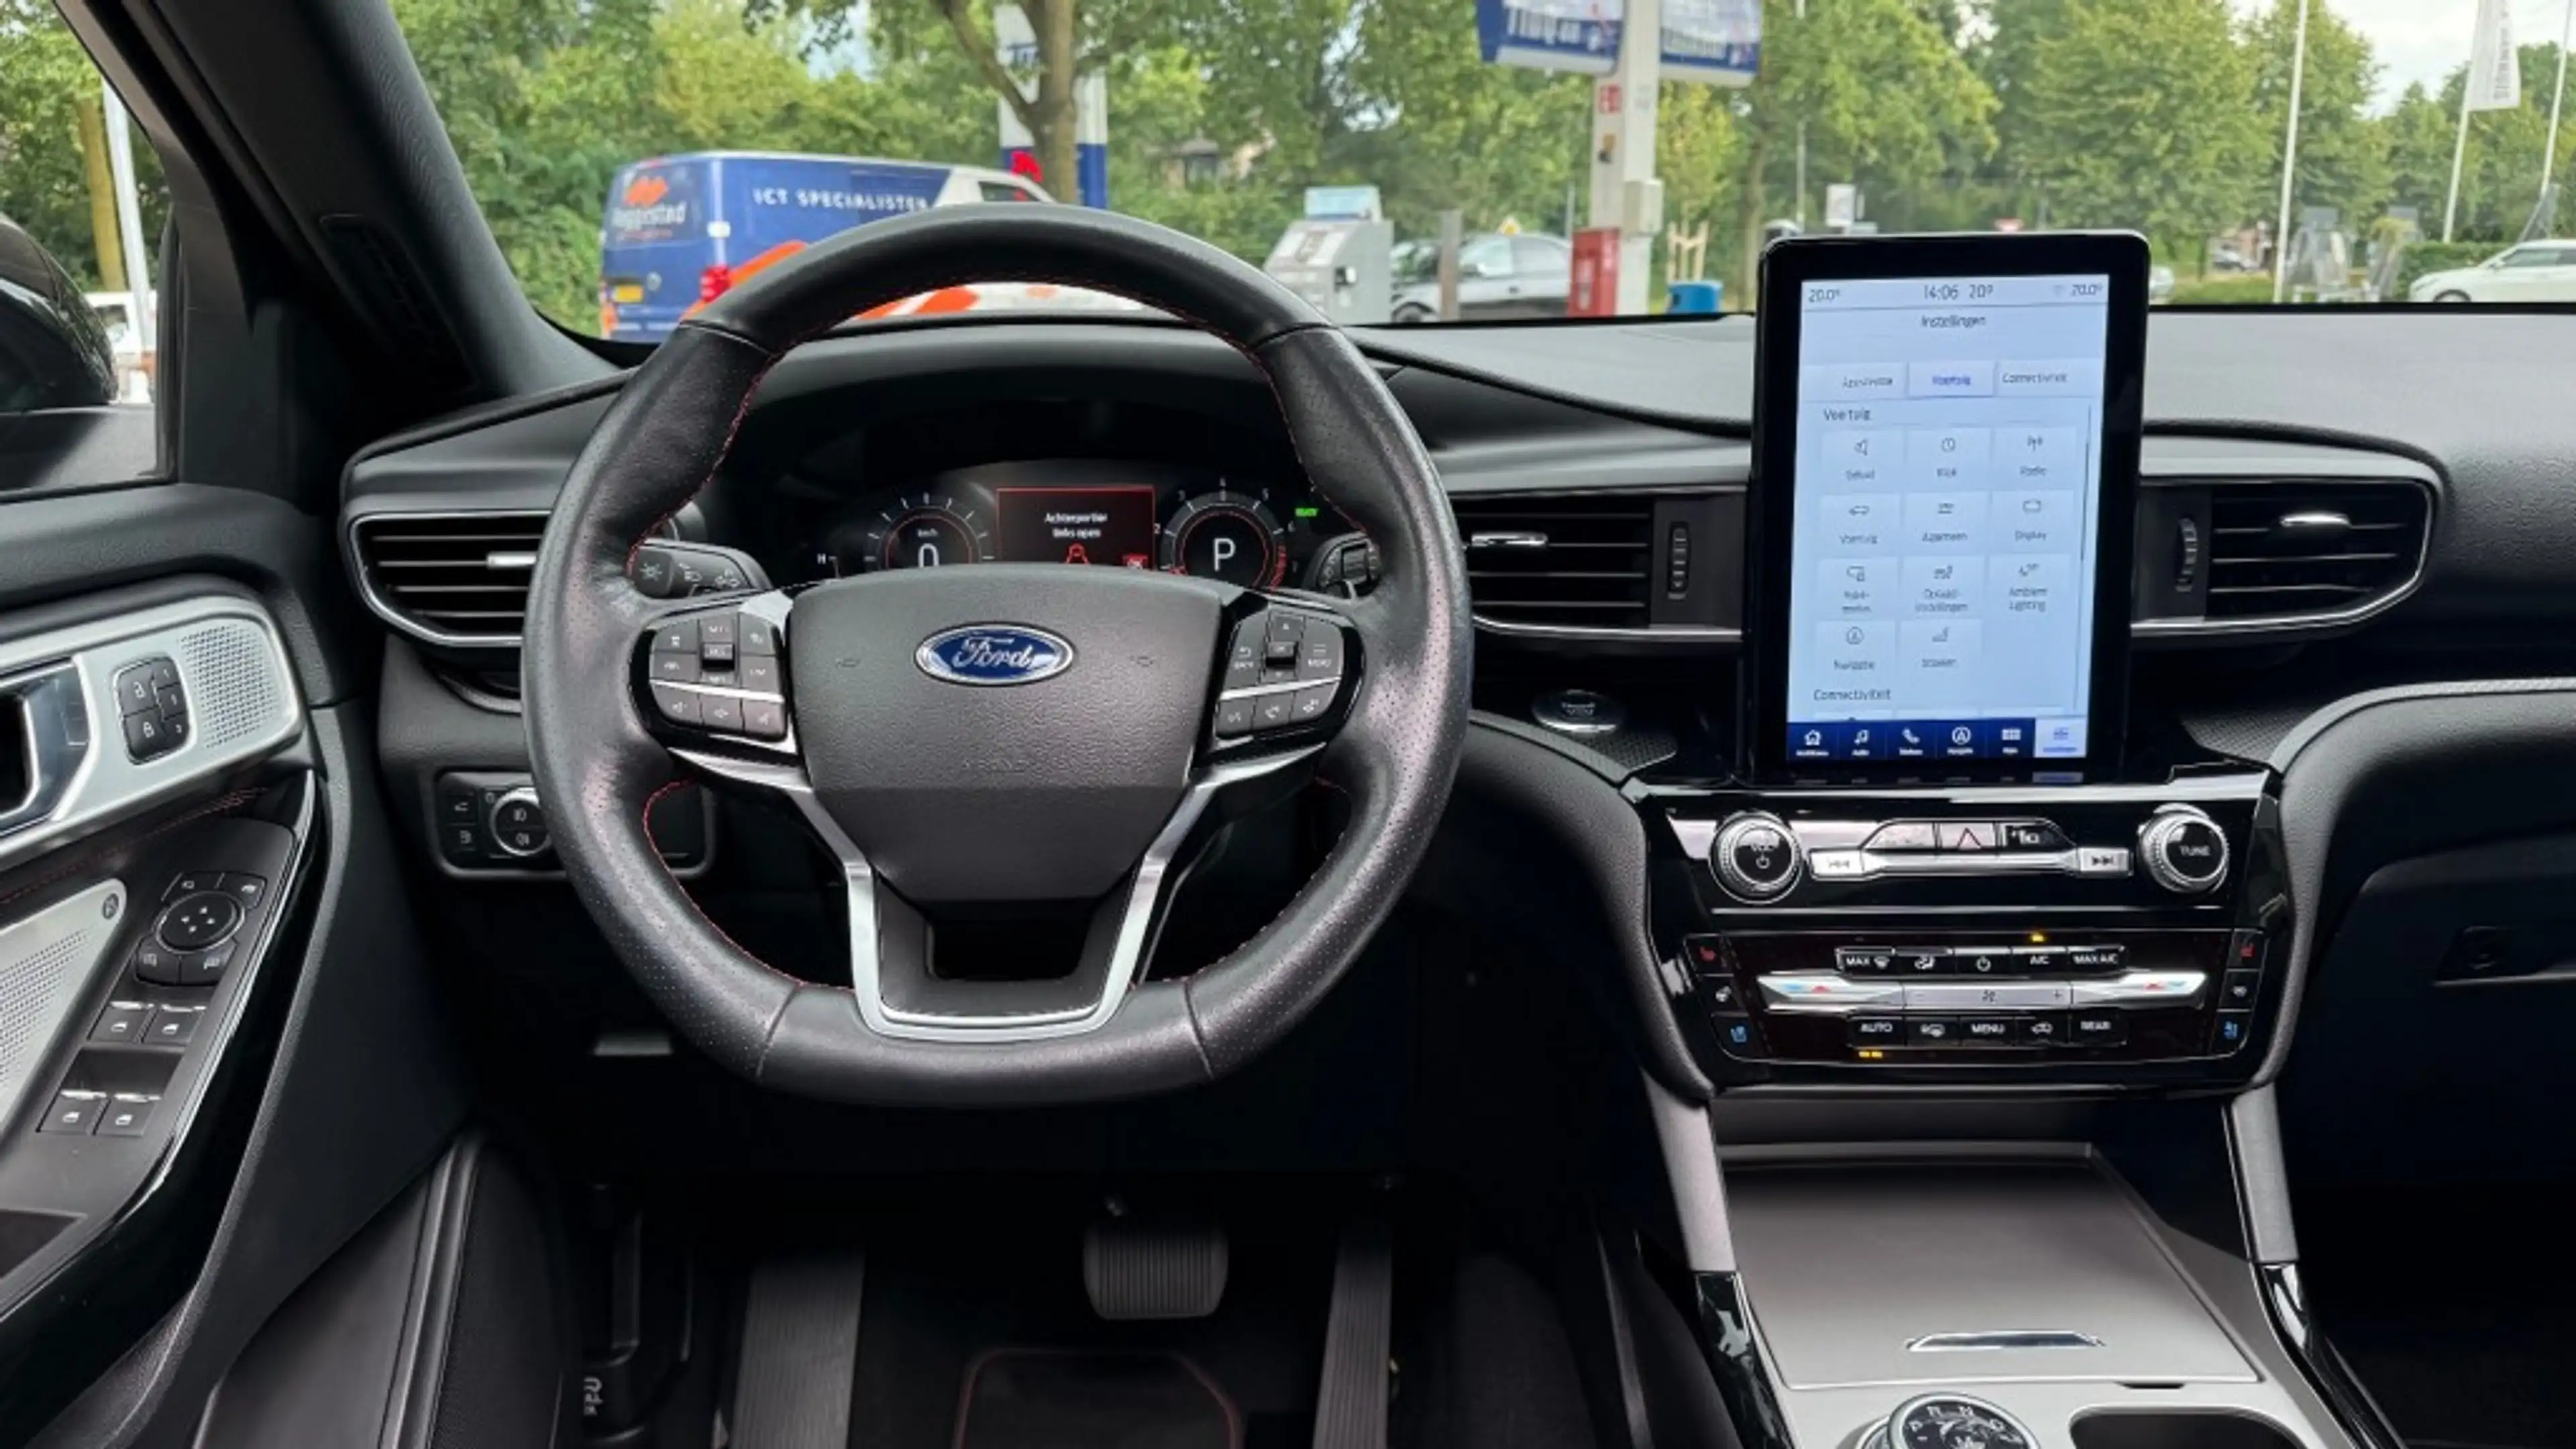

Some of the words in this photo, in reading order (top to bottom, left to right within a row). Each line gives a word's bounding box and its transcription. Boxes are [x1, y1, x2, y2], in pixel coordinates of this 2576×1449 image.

[753, 188, 788, 205] ICT
[1924, 284, 1959, 301] 14:06
[1921, 314, 1986, 329] Instellingen
[1044, 513, 1108, 525] Achterportier
[1212, 537, 1235, 572] P
[951, 636, 1034, 669] Ford
[2180, 845, 2210, 857] TUNE
[1846, 957, 1870, 967] MAX
[2029, 955, 2049, 965] A/C
[2073, 954, 2099, 965] MAX
[2100, 953, 2118, 965] A/C
[1860, 1022, 1892, 1033] AUTO
[1971, 1024, 2004, 1035] MENU
